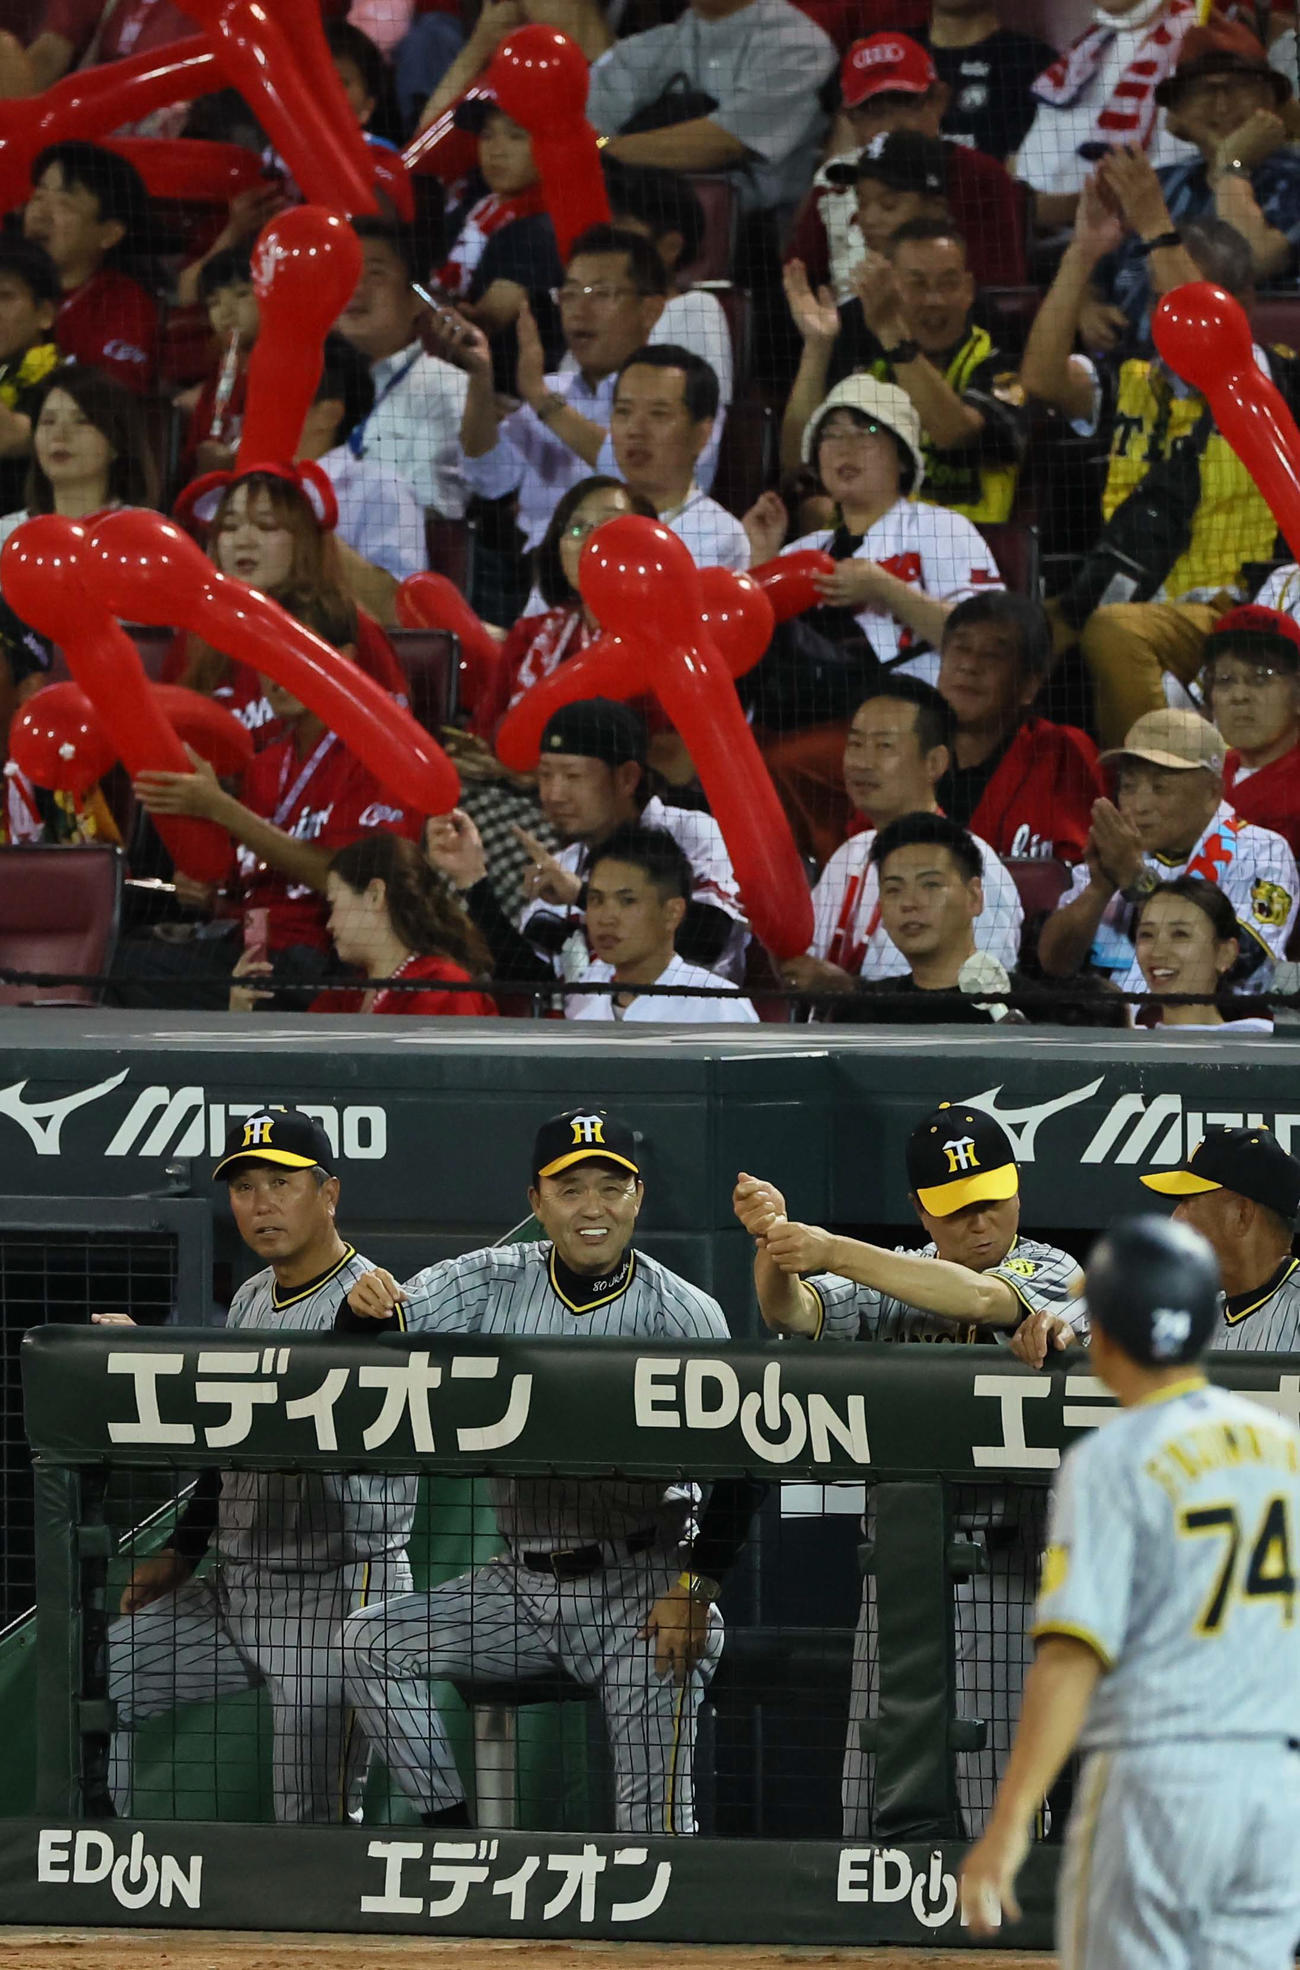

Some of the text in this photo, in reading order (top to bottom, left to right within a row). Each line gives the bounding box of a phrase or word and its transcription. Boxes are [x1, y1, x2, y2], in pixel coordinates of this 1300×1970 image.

[592, 1280, 608, 1292] 80
[107, 1347, 533, 1453] エディオン
[1174, 1492, 1297, 1636] 74
[361, 1839, 671, 1922] エディオン
